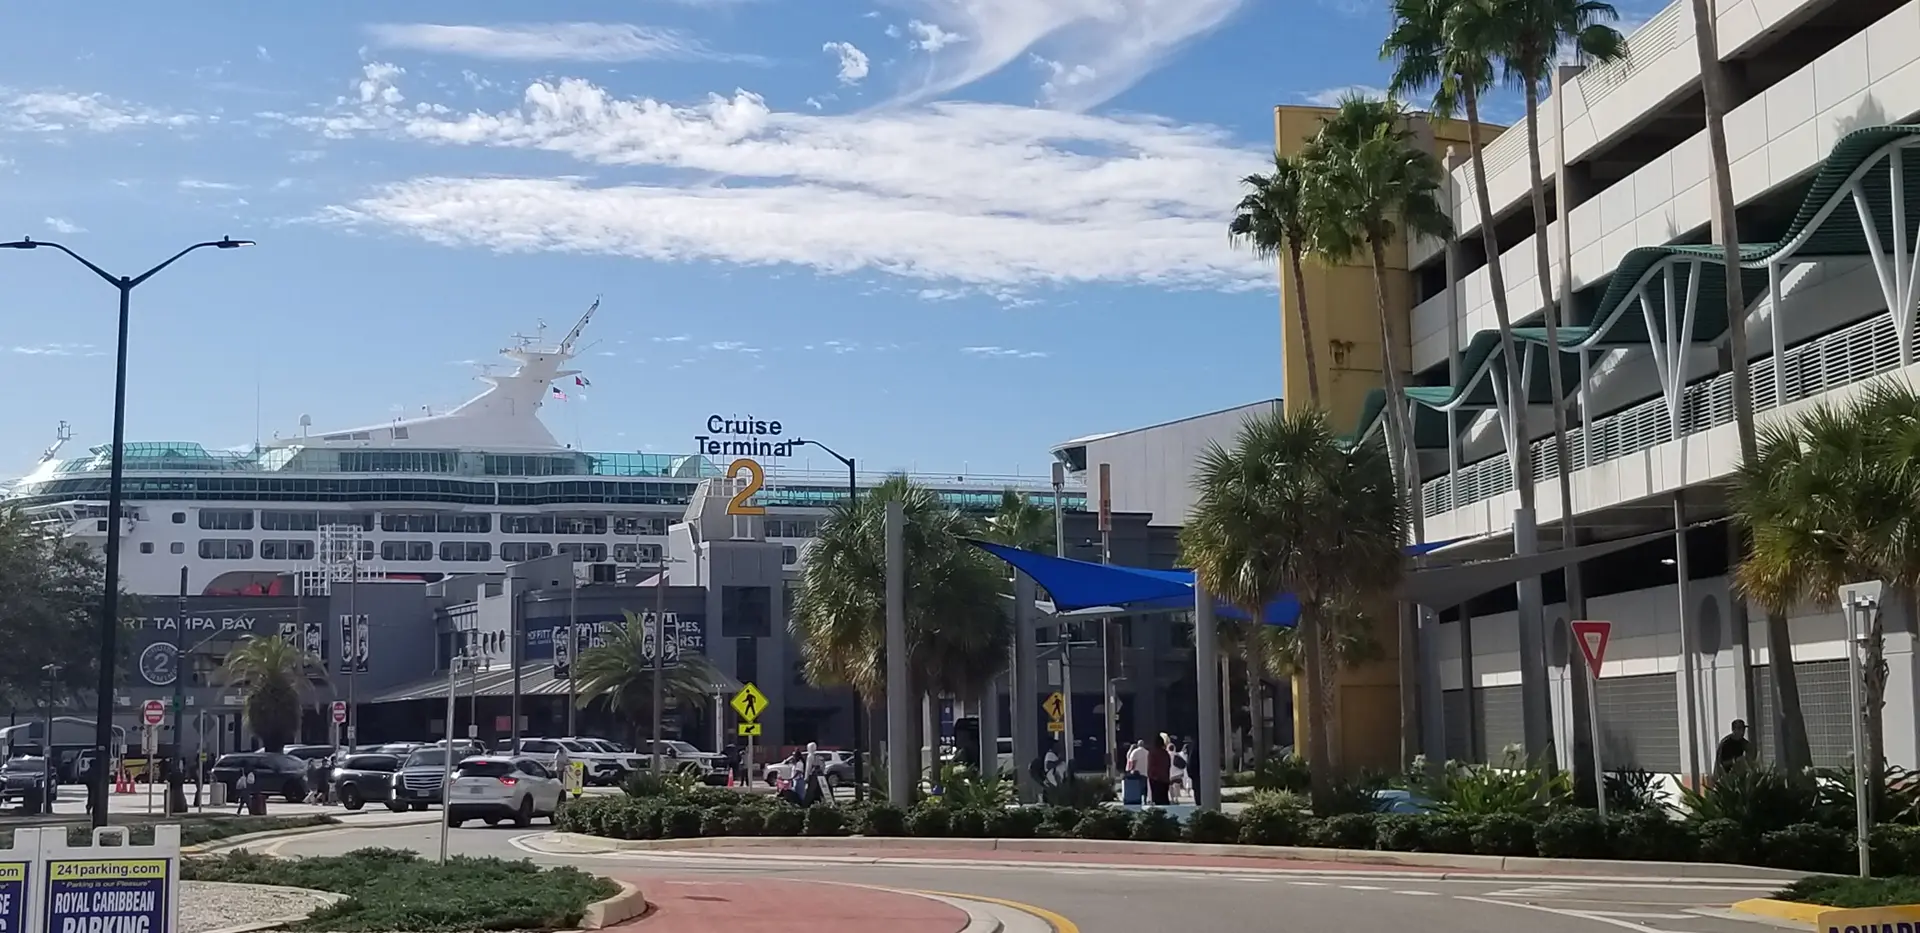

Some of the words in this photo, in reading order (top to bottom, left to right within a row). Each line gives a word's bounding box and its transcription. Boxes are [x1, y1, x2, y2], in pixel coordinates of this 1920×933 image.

[707, 414, 782, 434] Cruise
[695, 435, 793, 457] Terminal
[725, 458, 766, 516] 2
[222, 617, 256, 630] BAY
[153, 652, 169, 673] 2
[57, 863, 160, 876] 241parking.com
[55, 892, 90, 914] ROYAL
[92, 891, 155, 913] CARIBBEAN
[62, 915, 150, 933] PARKING
